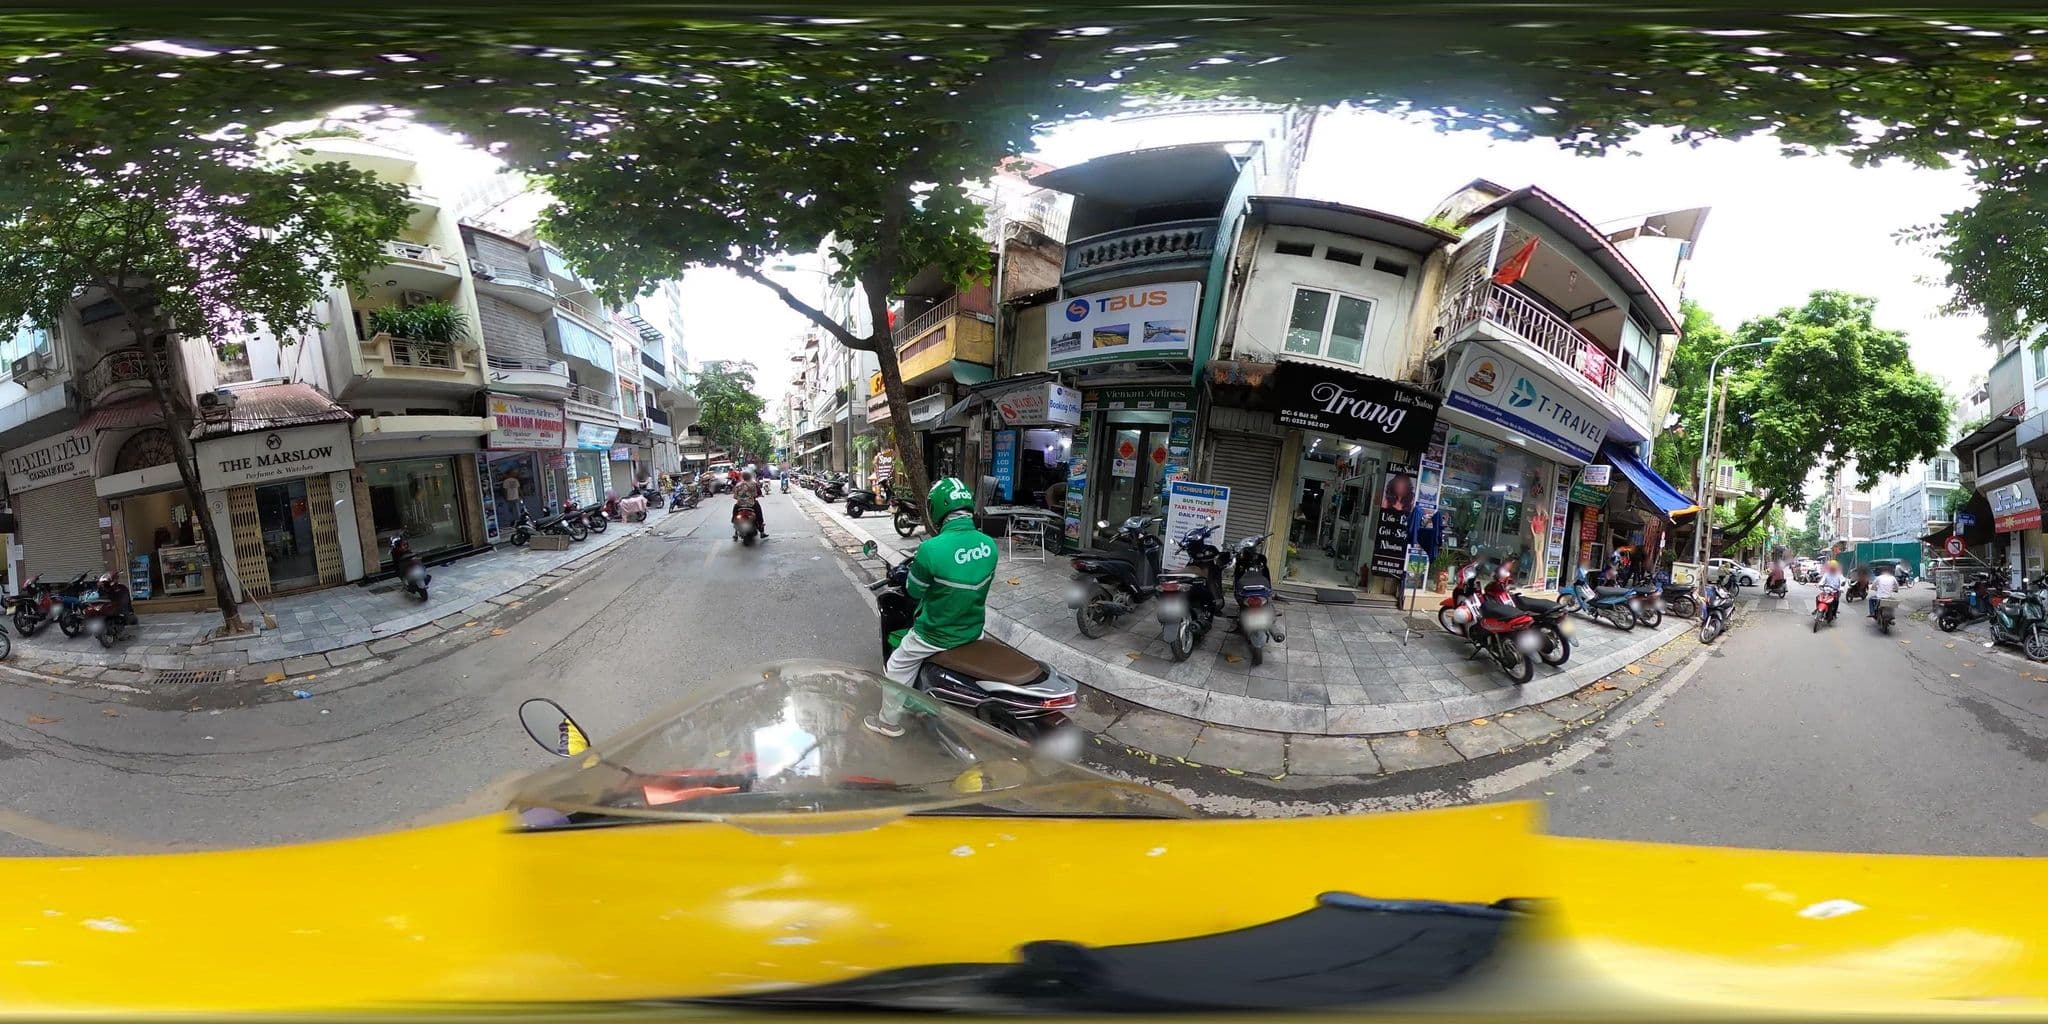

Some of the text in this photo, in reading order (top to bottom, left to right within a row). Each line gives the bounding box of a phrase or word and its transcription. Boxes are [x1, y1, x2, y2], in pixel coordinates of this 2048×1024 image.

[1096, 290, 1168, 312] TBUS
[1105, 389, 1185, 398] Vietnam Airlines
[1394, 390, 1434, 410] Hair Salon
[1049, 400, 1068, 413] Booking
[1311, 382, 1407, 433] Trang
[1537, 395, 1600, 444] T-TRAVEL
[219, 446, 333, 473] THE MARSLOW
[245, 470, 275, 479] Perfume
[950, 489, 972, 500] Grab
[1196, 507, 1221, 515] AIRPORT
[954, 541, 991, 565] Grab
